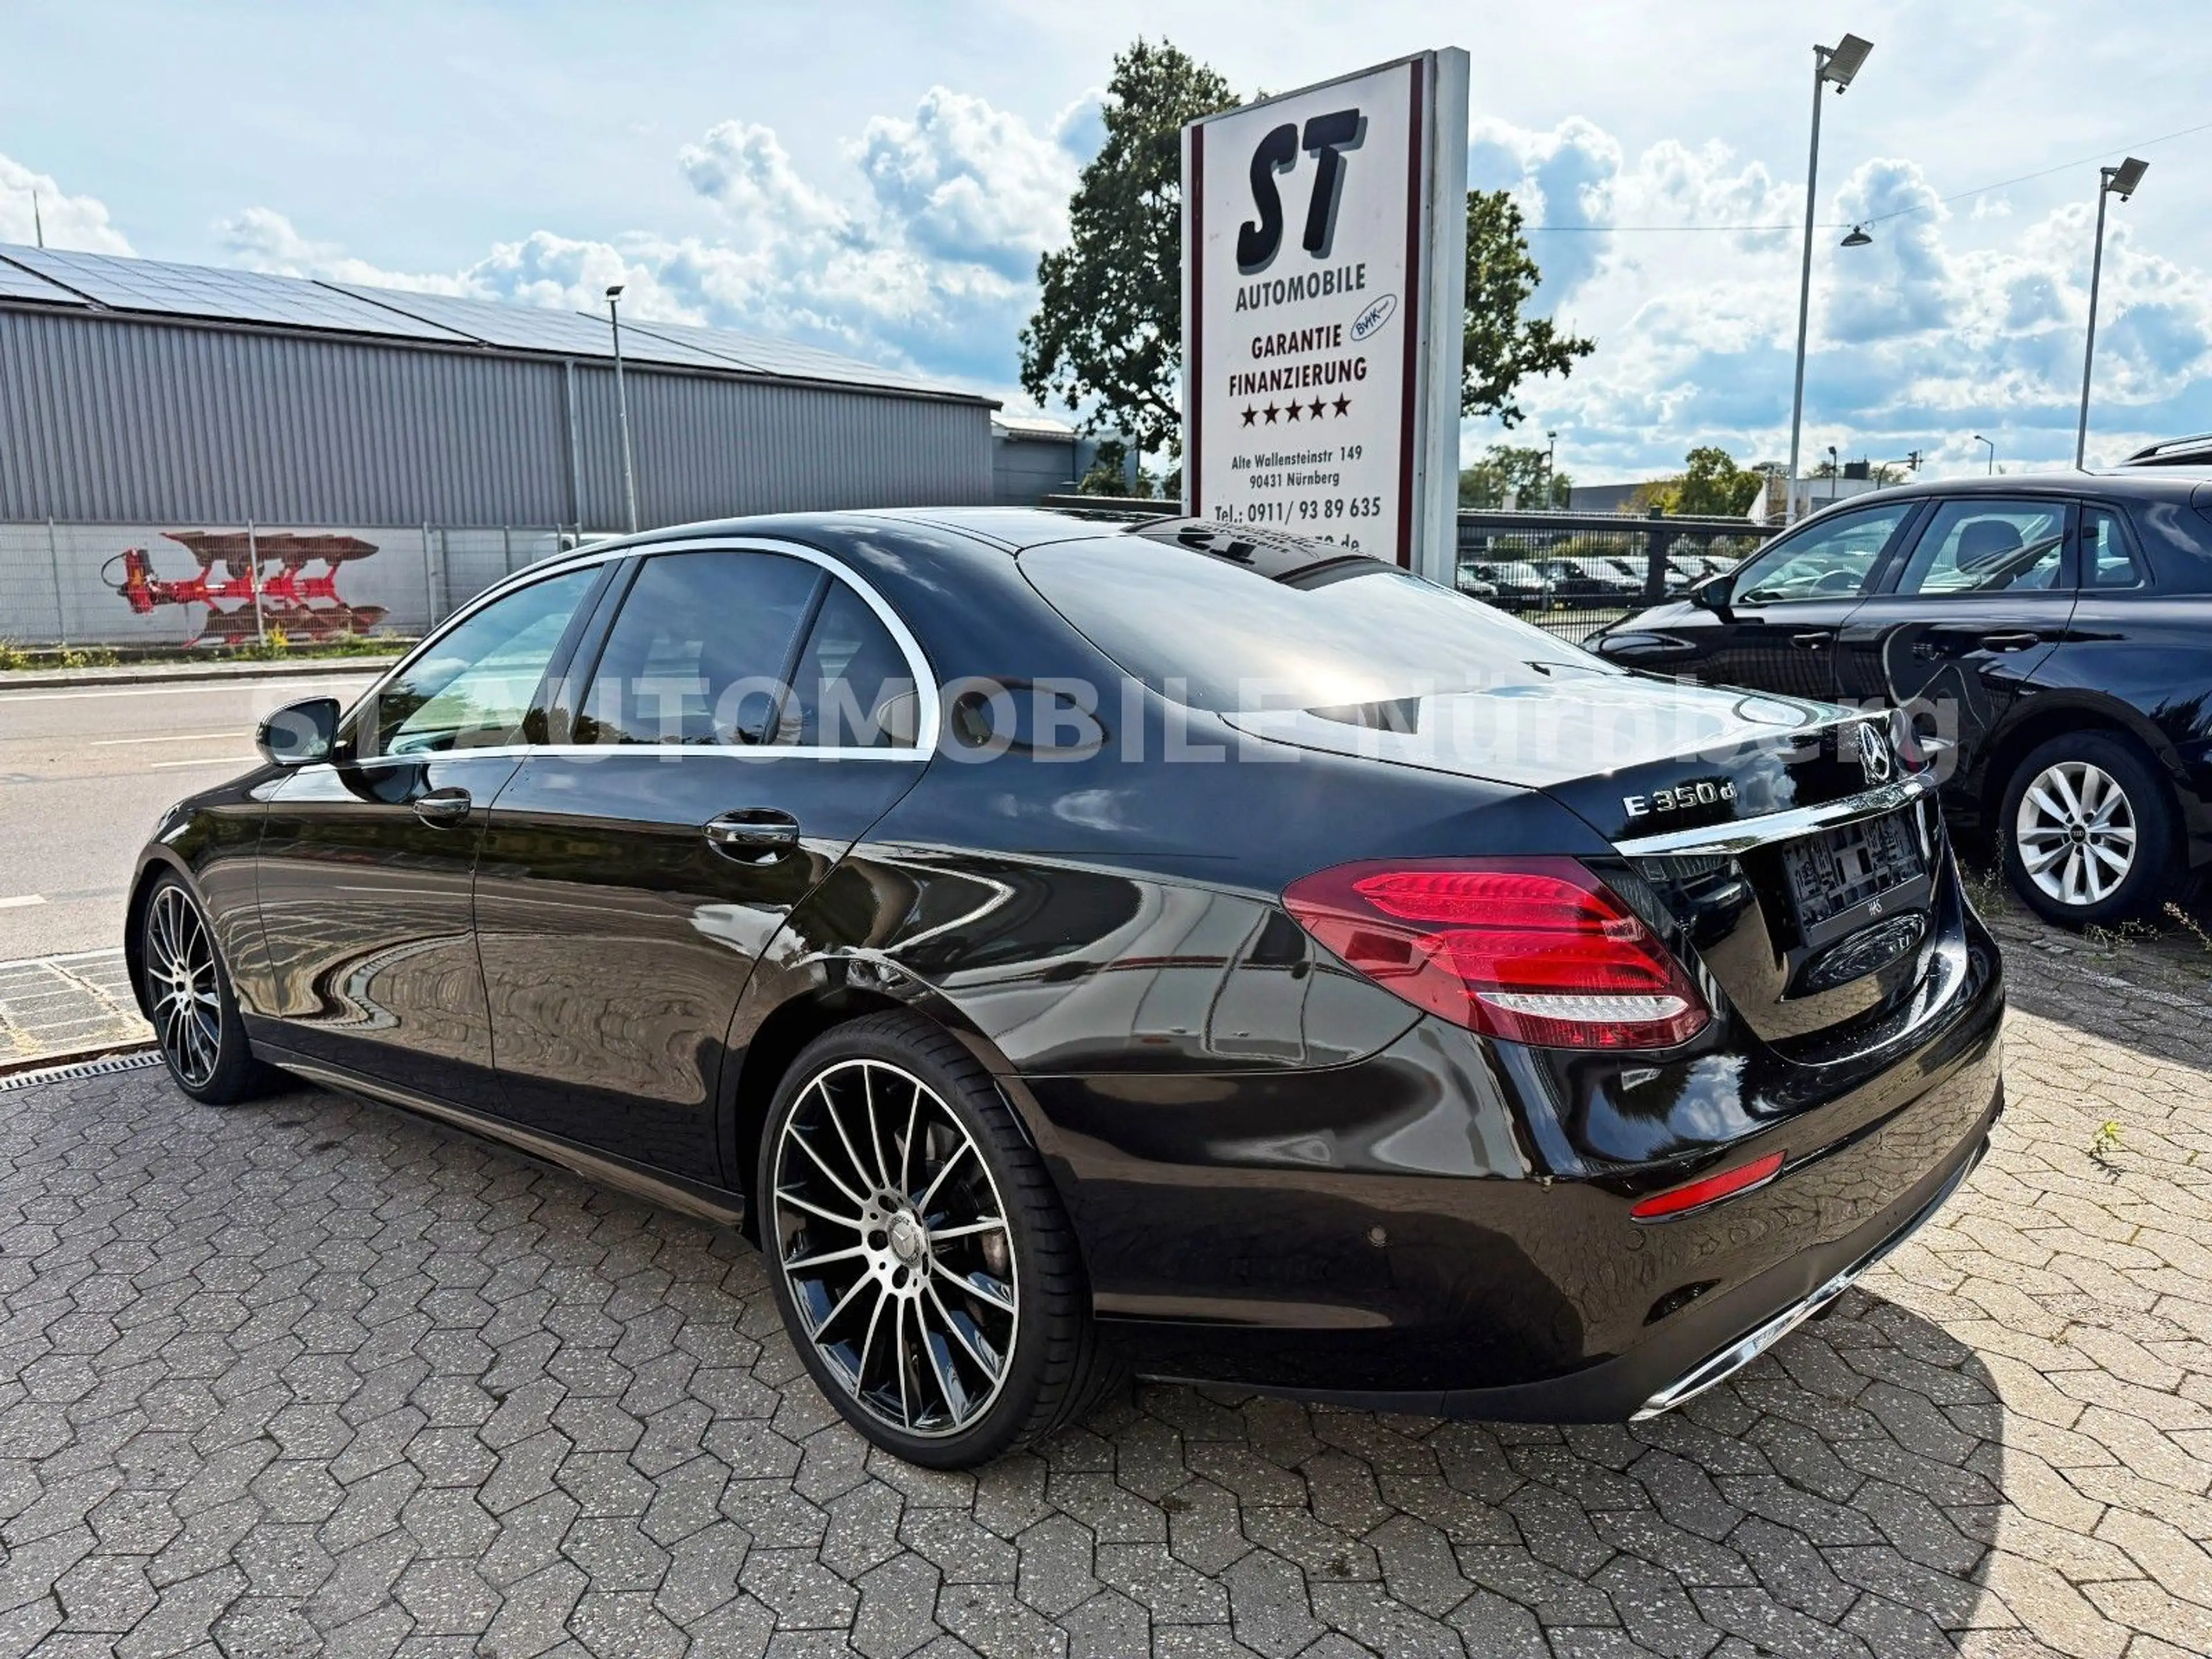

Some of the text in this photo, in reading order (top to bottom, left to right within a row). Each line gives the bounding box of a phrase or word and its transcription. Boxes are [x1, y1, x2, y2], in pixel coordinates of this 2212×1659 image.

[1236, 108, 1368, 276] ST
[1236, 263, 1366, 312] AUTOMOBILE
[1251, 324, 1342, 359] GARANTIE
[1229, 357, 1367, 396] FINANZIERUNG
[1232, 456, 1251, 469] Alte
[1340, 445, 1362, 461] 149
[1249, 469, 1340, 488] 90431 Nürnberg
[1215, 497, 1381, 525] Tel.: 0911/ 93 89 635
